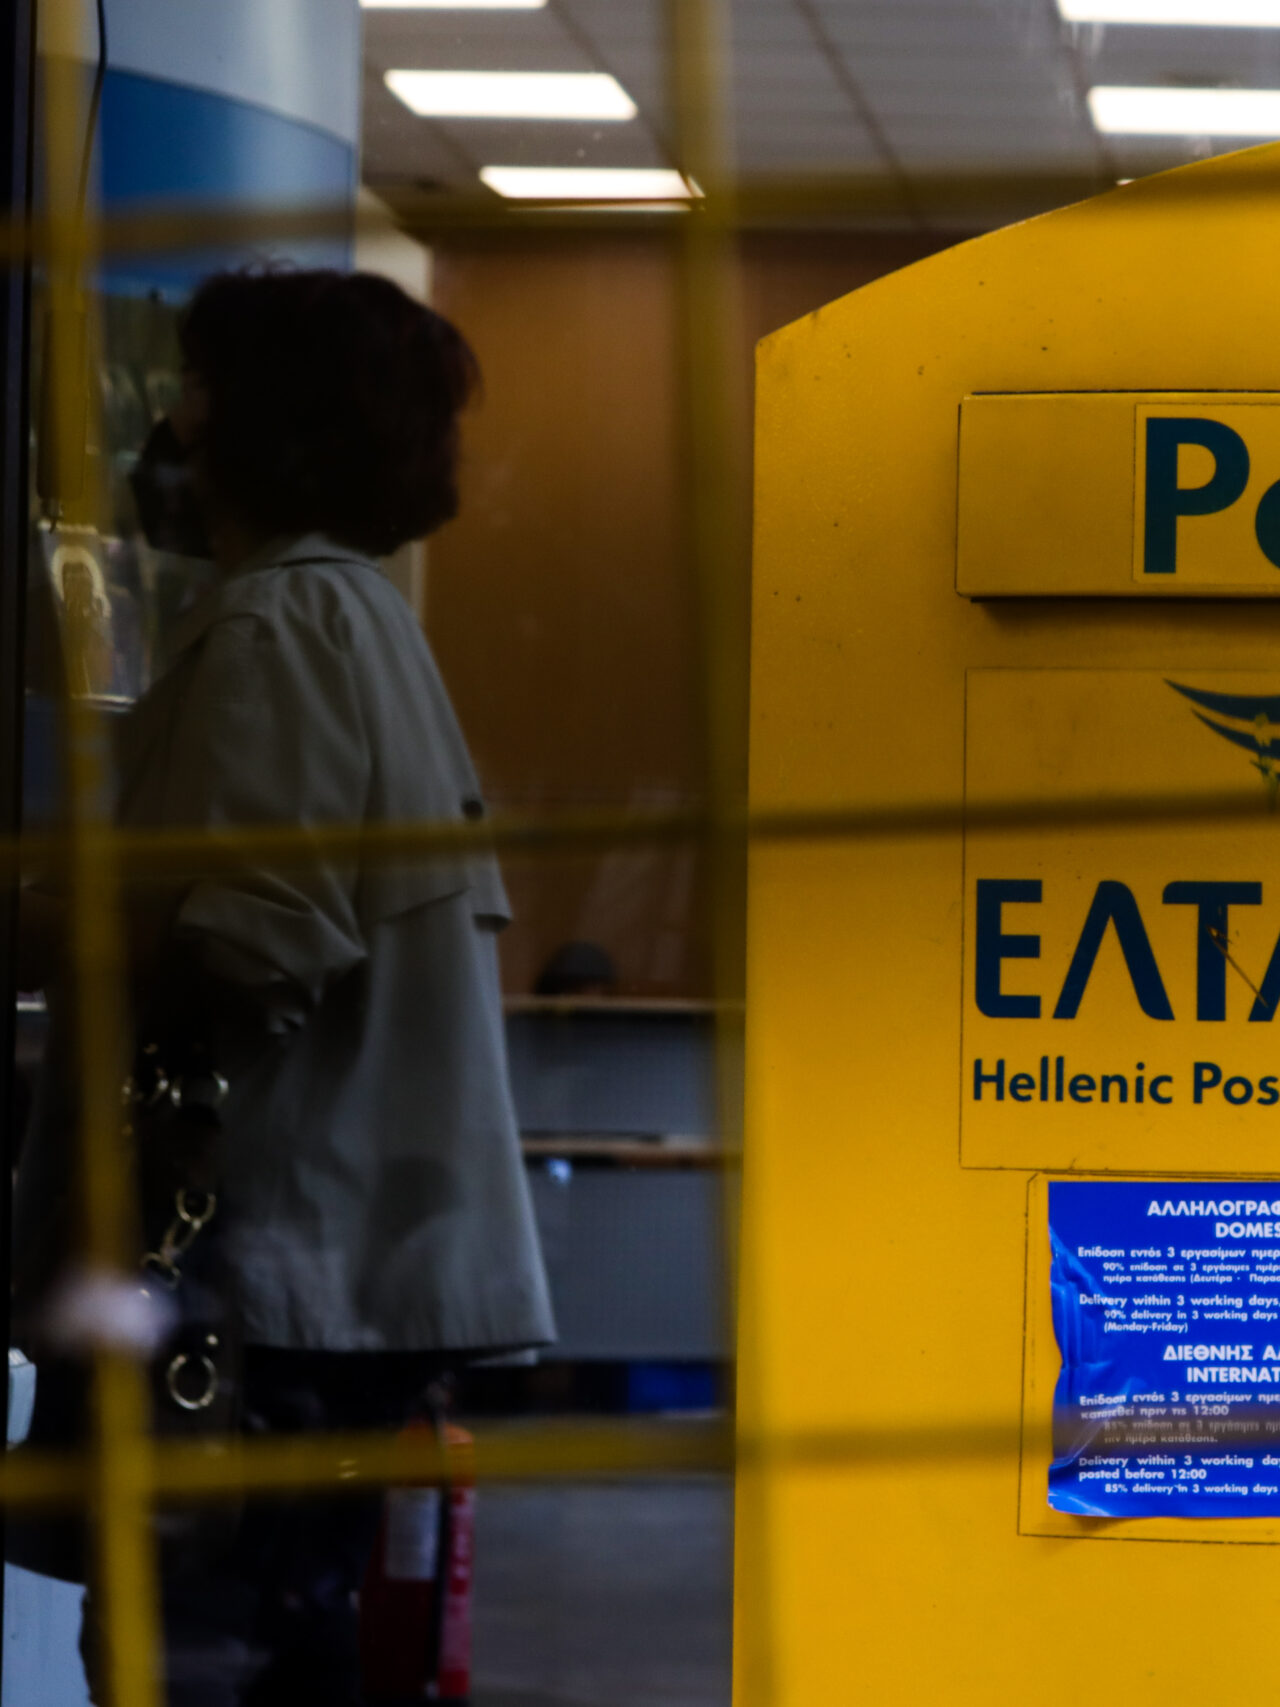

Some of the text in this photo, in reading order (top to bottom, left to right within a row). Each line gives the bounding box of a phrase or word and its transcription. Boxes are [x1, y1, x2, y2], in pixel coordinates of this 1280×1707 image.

[972, 1056, 1173, 1105] Hellenic
[1077, 1245, 1125, 1258] Επίδοση
[1167, 1246, 1175, 1258] 3
[1102, 1262, 1125, 1272] 90%
[1190, 1262, 1197, 1272] 3
[1079, 1293, 1128, 1308] Delivery
[1132, 1294, 1171, 1306] within
[1176, 1294, 1185, 1306] 3
[1190, 1294, 1243, 1308] working
[1104, 1310, 1127, 1319] 90%
[1130, 1310, 1173, 1321] delivery
[1177, 1310, 1187, 1319] in
[1192, 1310, 1199, 1319] 3
[1203, 1310, 1248, 1322] working
[1252, 1310, 1278, 1322] days
[1103, 1322, 1189, 1333] (Monday-Friday)
[1163, 1344, 1254, 1361] ΔΙΕΘΝΗΣ
[1171, 1391, 1180, 1402] 3
[1193, 1405, 1230, 1416] 12:00
[1078, 1455, 1129, 1468] Delivery
[1136, 1454, 1176, 1465] within
[1184, 1455, 1193, 1465] 3
[1201, 1454, 1254, 1468] working
[1078, 1468, 1207, 1482] posted before 12:00
[1104, 1483, 1128, 1493] 85%
[1132, 1483, 1174, 1495] delivery
[1177, 1483, 1188, 1493] in
[1192, 1483, 1200, 1493] 3
[1204, 1483, 1249, 1495] working
[1252, 1483, 1278, 1495] days
